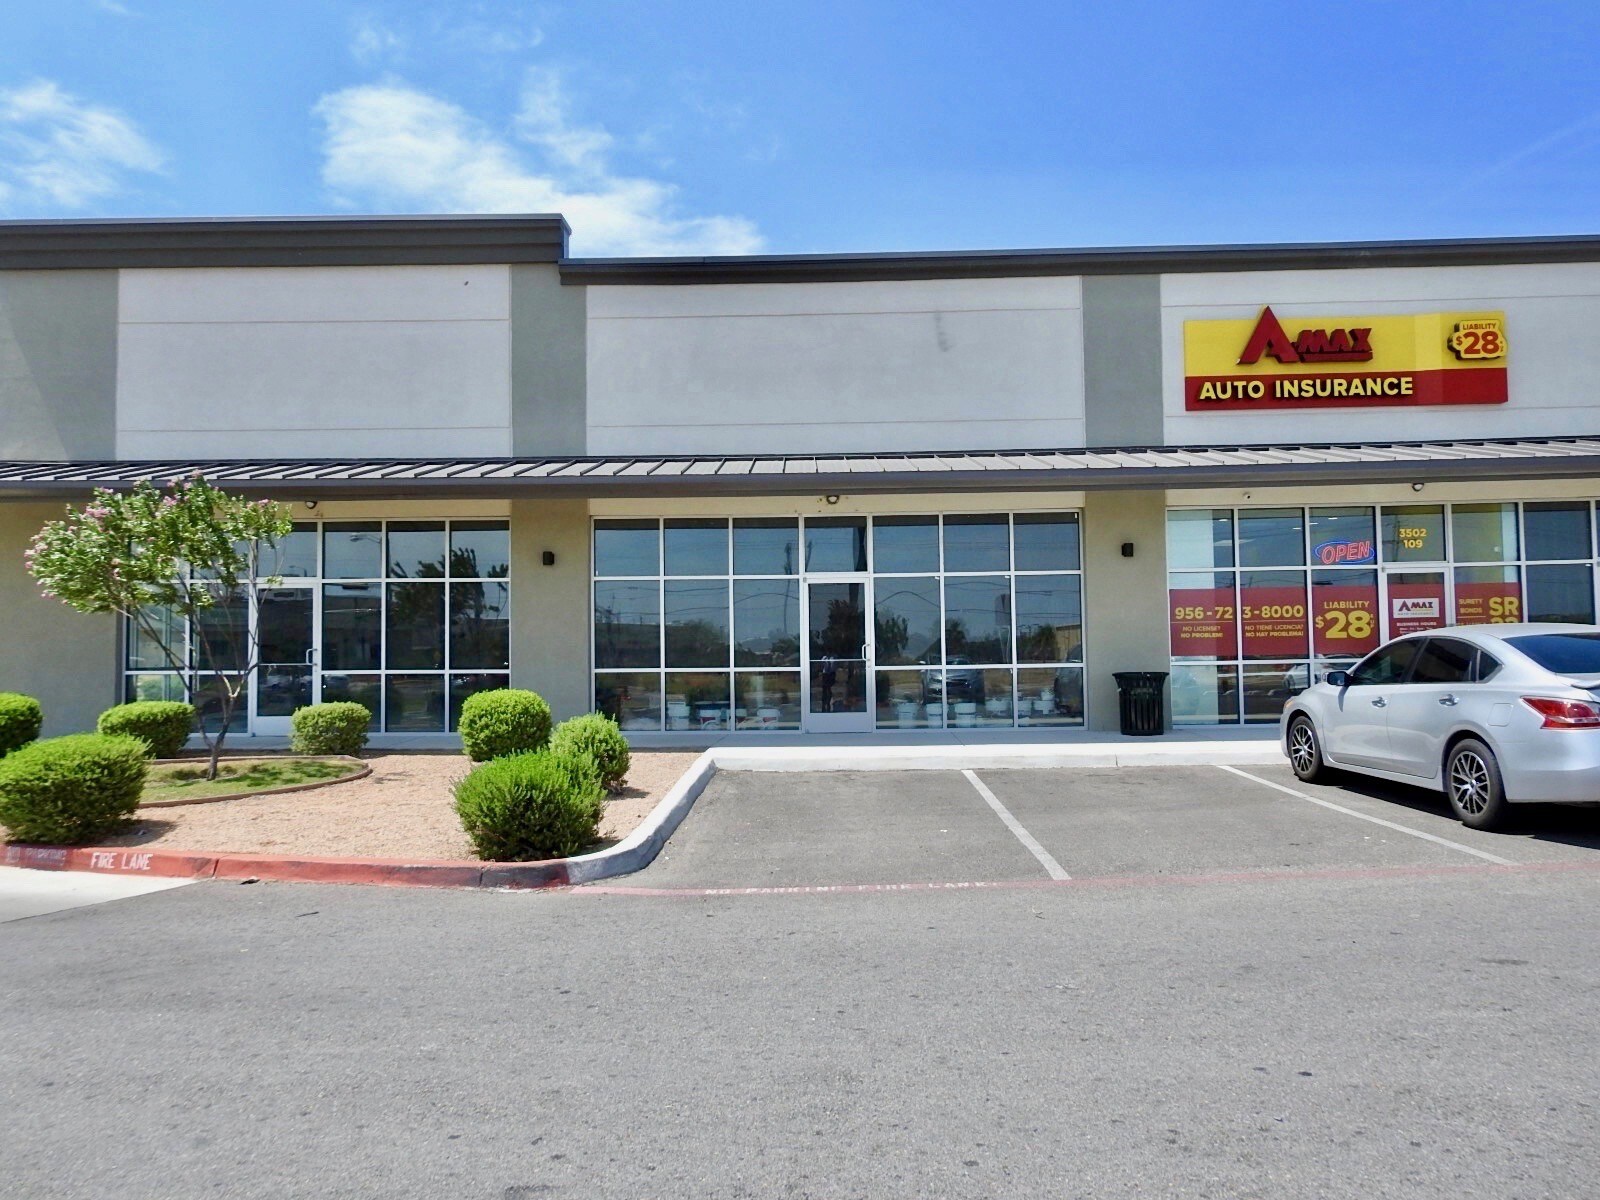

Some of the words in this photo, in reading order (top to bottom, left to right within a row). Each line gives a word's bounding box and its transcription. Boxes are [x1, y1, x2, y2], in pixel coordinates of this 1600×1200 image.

[1455, 330, 1499, 354] $28
[1200, 381, 1265, 400] AUTO
[1275, 377, 1414, 398] INSURANCE
[1399, 528, 1427, 538] 3502
[1321, 541, 1370, 564] OPEN
[1403, 539, 1424, 549] 109
[1324, 600, 1370, 609] LIABILITY
[1489, 596, 1519, 616] SR
[1315, 610, 1371, 639] $28
[90, 852, 118, 869] FIRE
[121, 853, 154, 870] LANE
